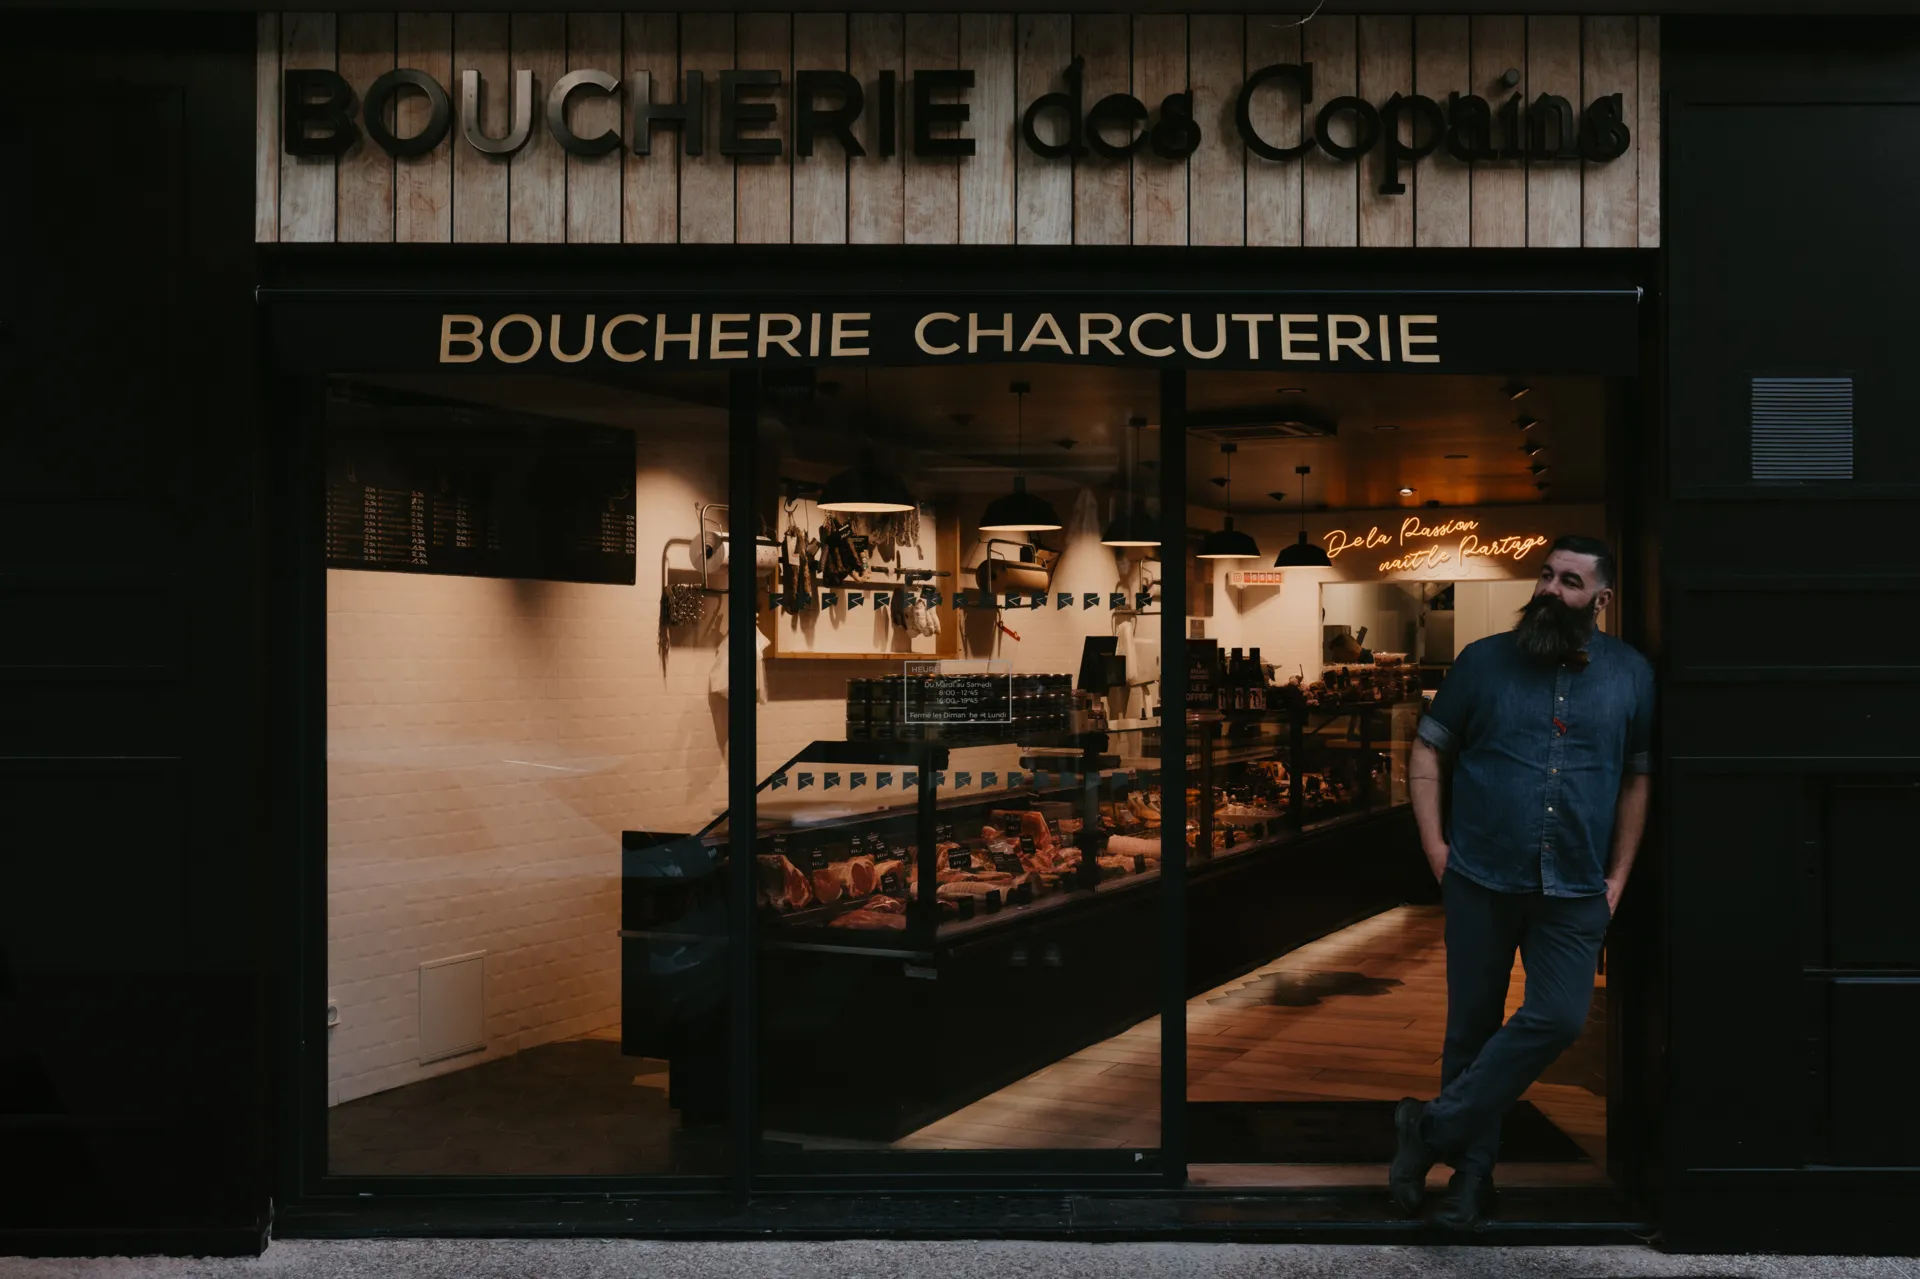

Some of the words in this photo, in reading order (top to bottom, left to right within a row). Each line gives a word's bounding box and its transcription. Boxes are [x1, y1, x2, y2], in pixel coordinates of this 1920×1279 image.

[284, 67, 976, 157] BOUCHERIE
[1020, 55, 1202, 160] des
[1235, 62, 1631, 195] Copains
[439, 312, 871, 364] BOUCHERIE
[914, 311, 1441, 364] CHARCUTERIE
[1400, 516, 1479, 546] Passion
[1458, 534, 1548, 567] Partage
[935, 681, 956, 689] Mardi
[966, 681, 992, 689] Samedi
[909, 711, 932, 719] Fermé
[932, 711, 942, 719] les
[987, 711, 1007, 719] Lundi
